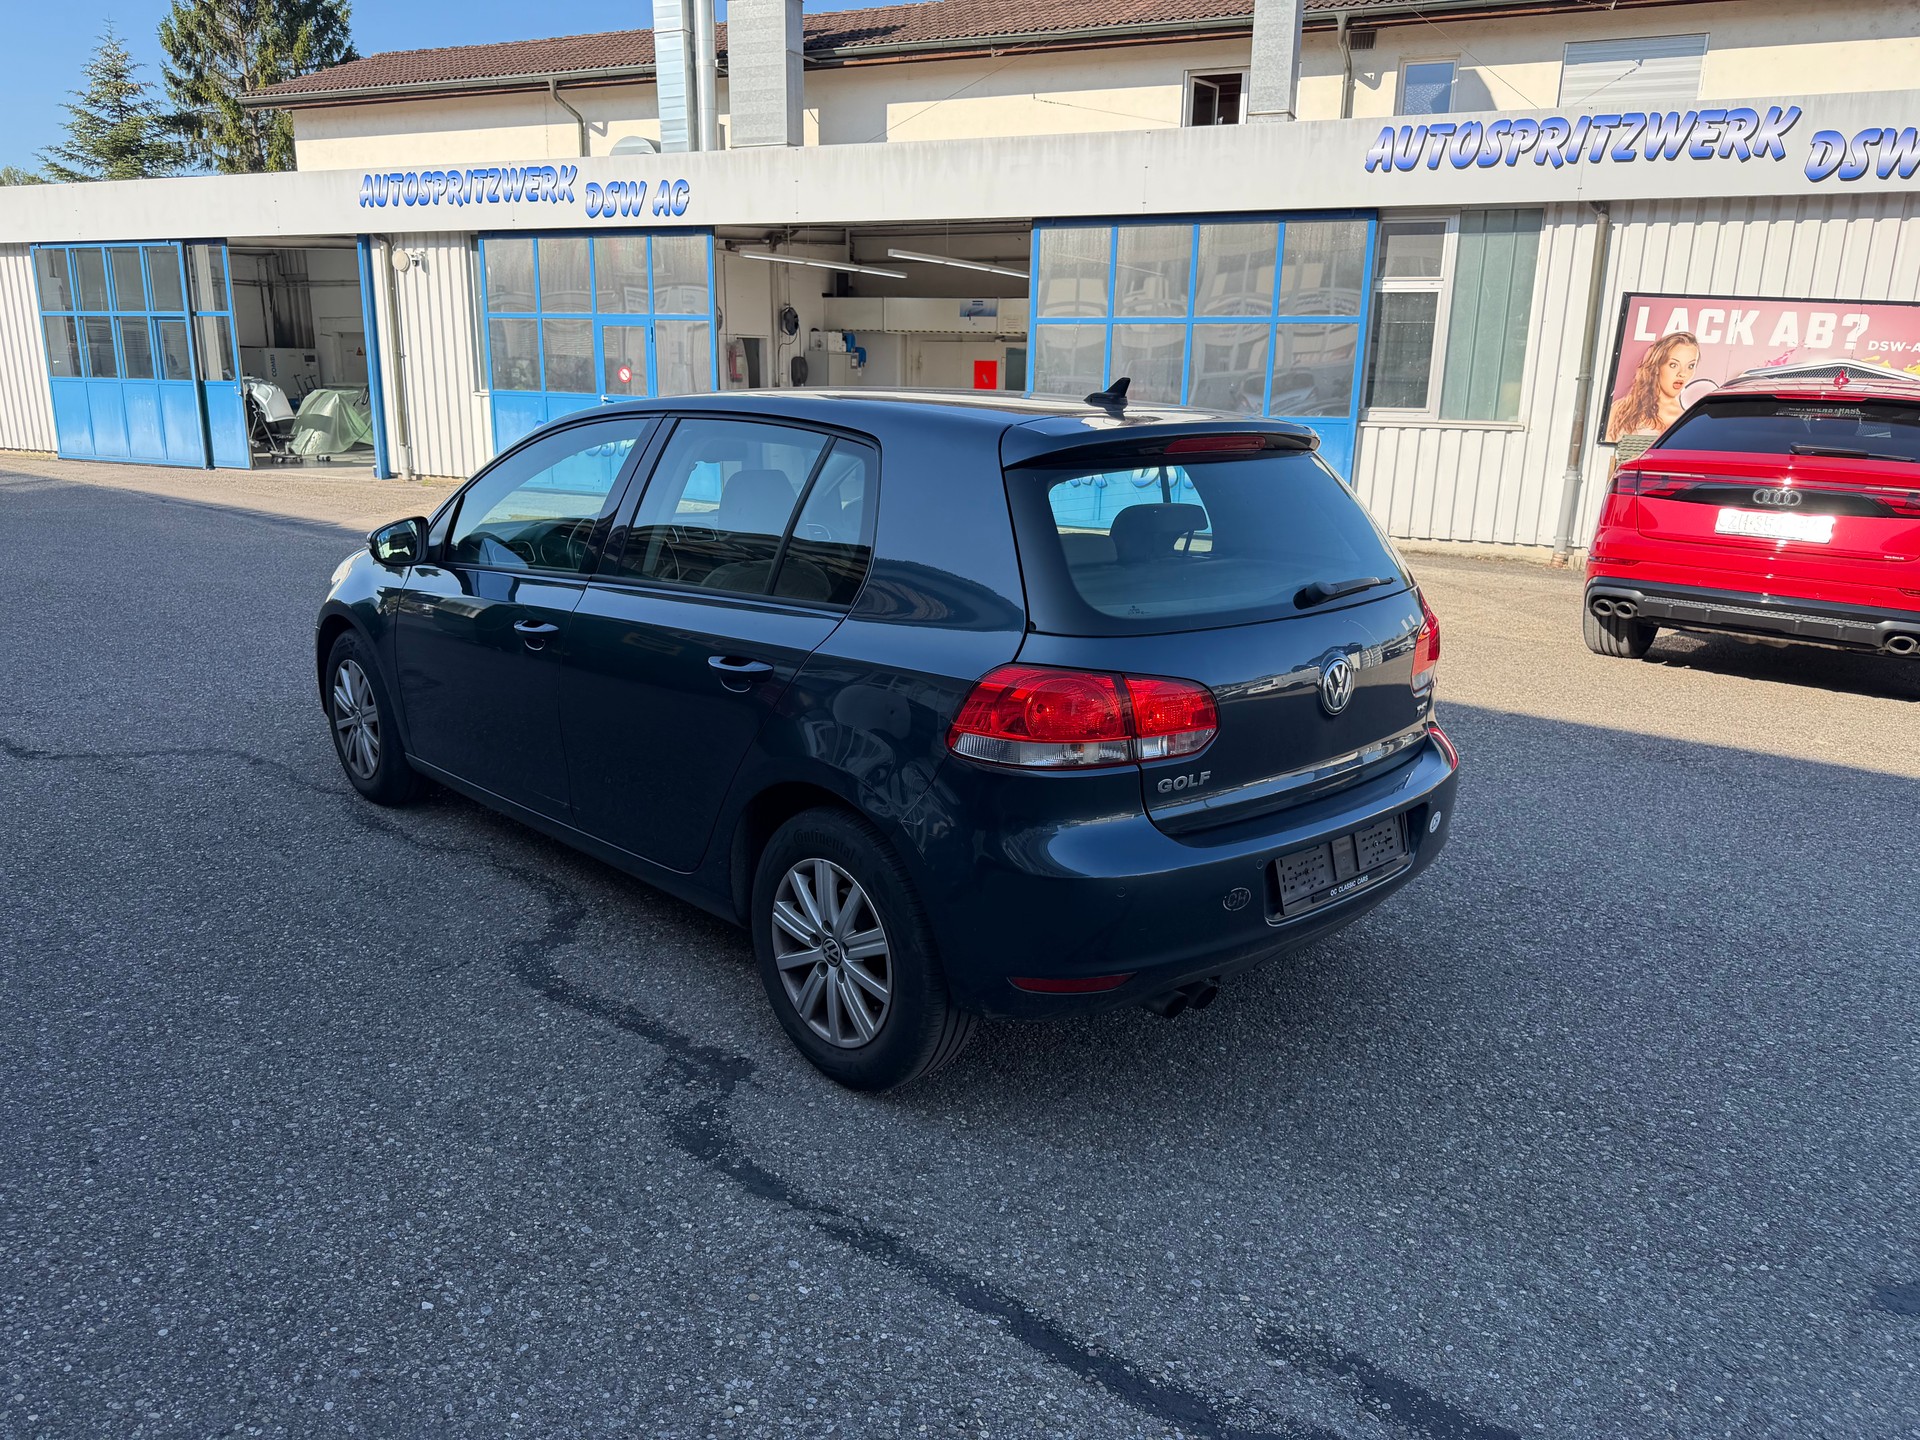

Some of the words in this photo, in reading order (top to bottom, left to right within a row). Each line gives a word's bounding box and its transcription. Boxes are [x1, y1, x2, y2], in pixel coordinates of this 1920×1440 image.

[1365, 106, 1802, 174] AUTOSPRITZWERK
[1804, 127, 1920, 183] DSW
[359, 165, 578, 208] AUTOSPRITZWERK
[585, 180, 647, 219] DSW
[652, 178, 690, 217] AG
[1633, 306, 1760, 346] LACK
[1768, 310, 1871, 350] AB?
[1157, 770, 1212, 794] GOLF
[1338, 880, 1356, 893] CLASSIC
[1357, 874, 1369, 885] CARS
